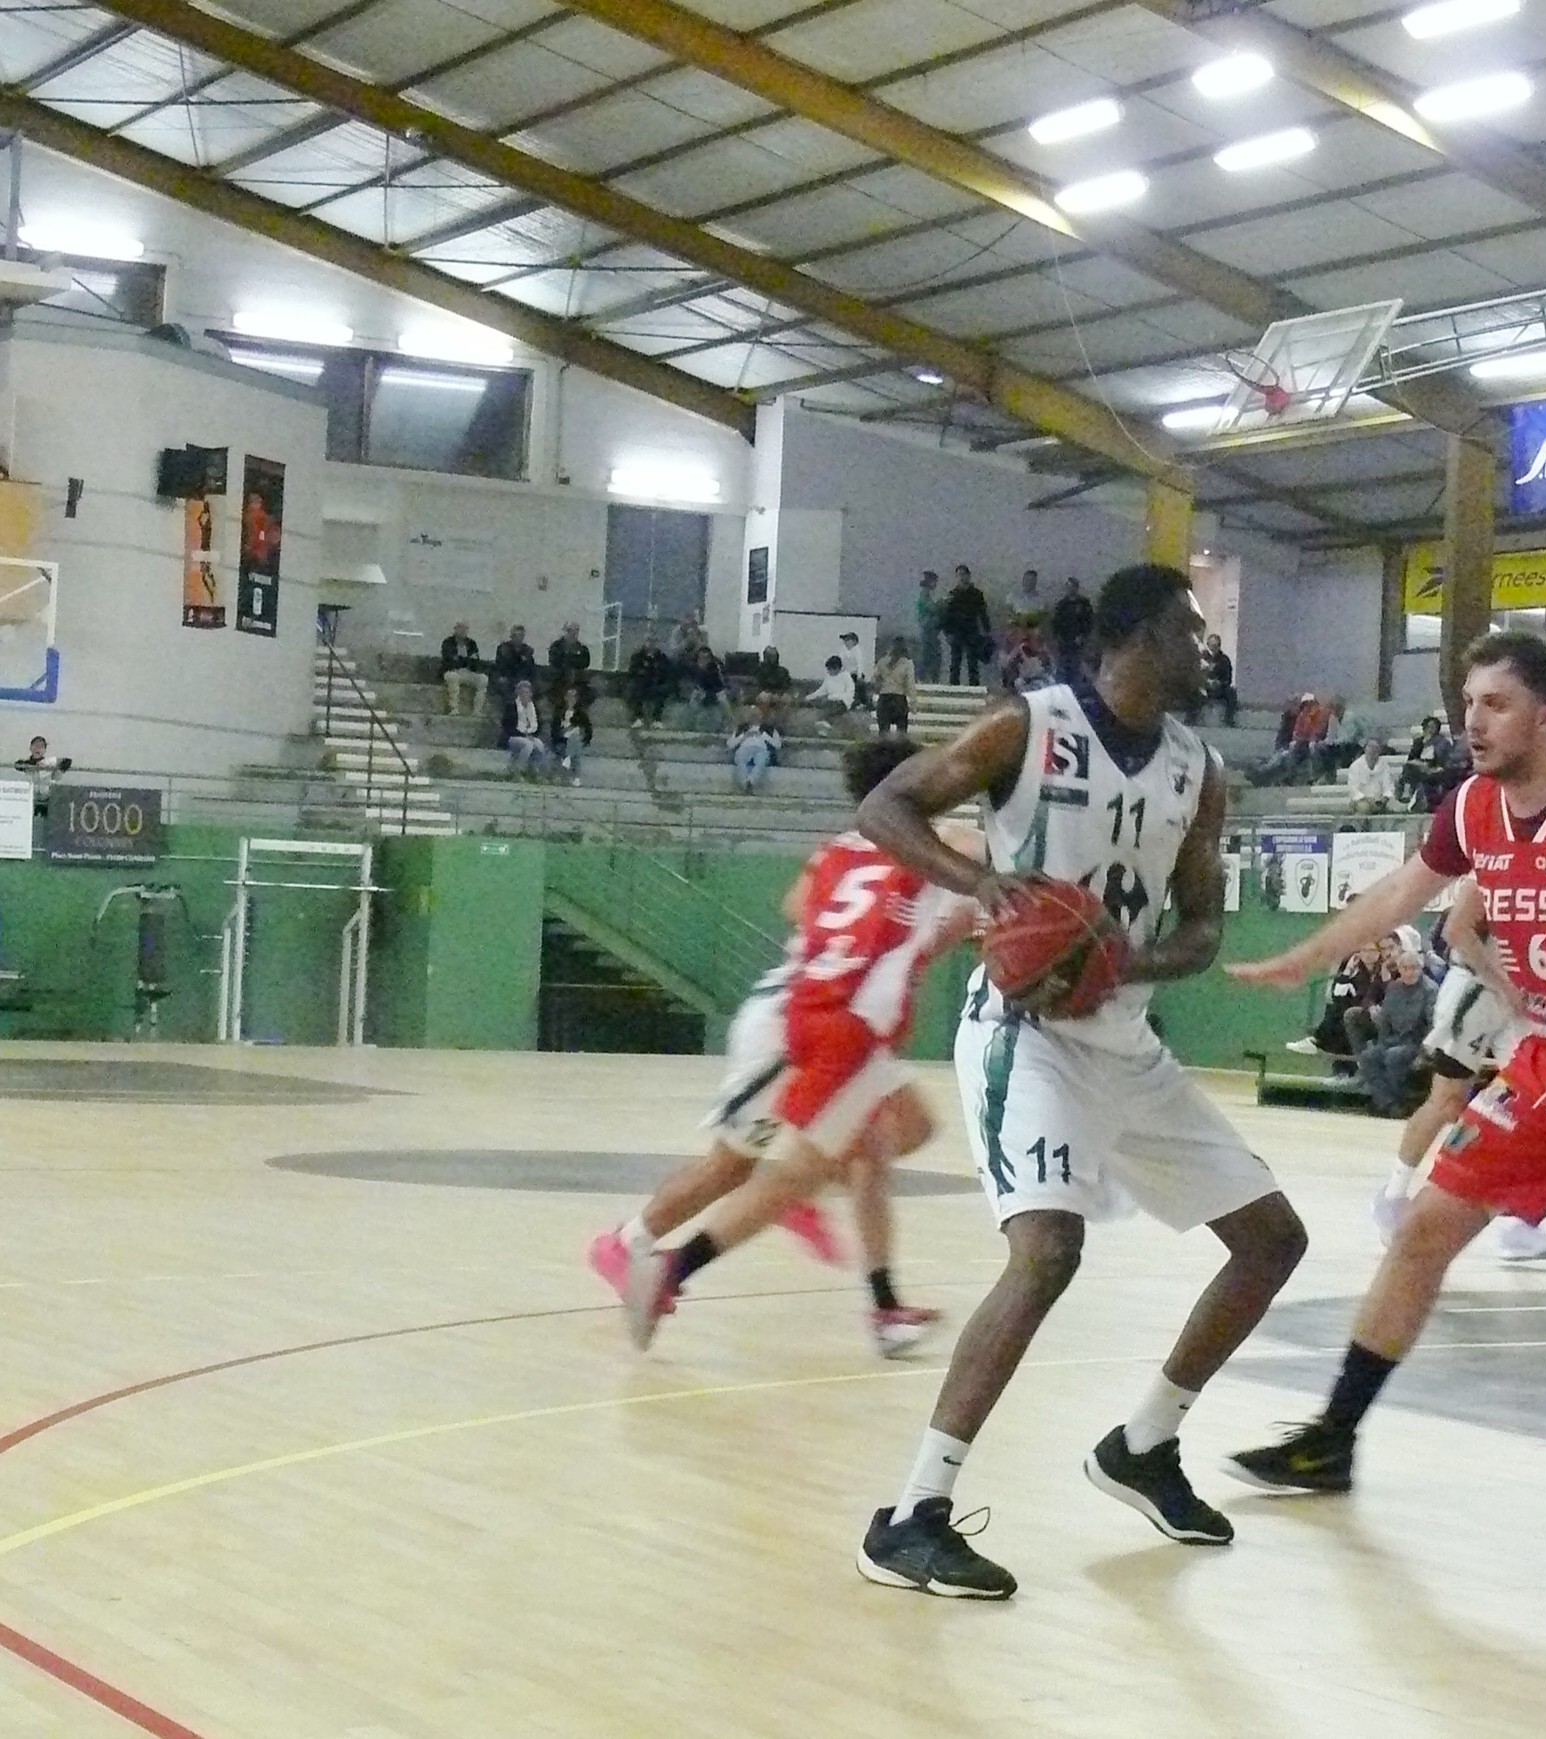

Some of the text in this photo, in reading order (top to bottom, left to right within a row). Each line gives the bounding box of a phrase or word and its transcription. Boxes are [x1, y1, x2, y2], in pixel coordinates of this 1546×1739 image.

[68, 801, 143, 836] 1000
[1106, 793, 1148, 850] 11
[815, 864, 895, 930] 5
[1026, 1136, 1073, 1185] 11
